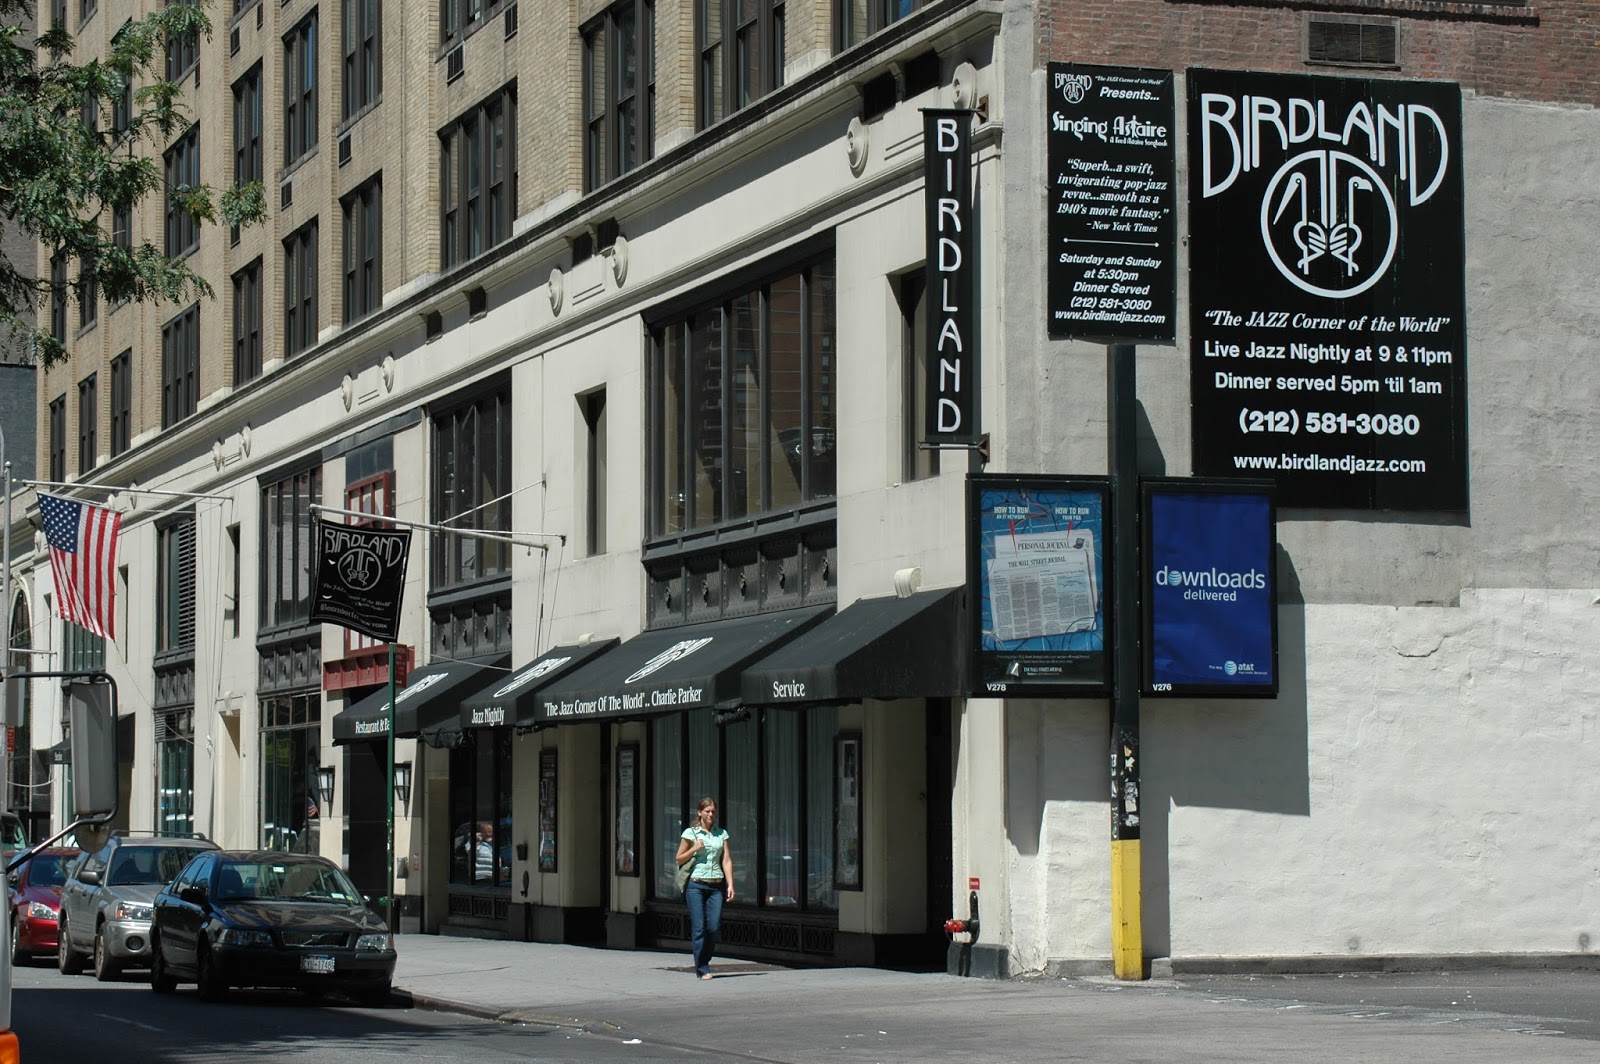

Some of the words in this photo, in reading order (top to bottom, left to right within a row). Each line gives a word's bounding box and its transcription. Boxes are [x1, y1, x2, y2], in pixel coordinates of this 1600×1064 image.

[1054, 72, 1092, 91] BIRDLAND
[1100, 86, 1160, 101] Presents...
[1052, 111, 1108, 143] Singing
[1113, 115, 1167, 138] Astaire
[1127, 138, 1144, 146] Astaire
[1145, 139, 1168, 148] Songbook
[1201, 93, 1449, 207] BIRDLAND
[1125, 163, 1154, 176] swift,
[1057, 173, 1122, 190] invigorating
[1123, 178, 1167, 191] pop-jazz
[1062, 189, 1137, 204] revue...smooth
[1139, 195, 1151, 204] as
[1152, 196, 1160, 204] a
[1056, 202, 1087, 215] 1940's
[1089, 204, 1118, 217] movie
[1120, 206, 1169, 220] fantasy."
[1112, 221, 1132, 232] York
[1133, 221, 1158, 233] Times
[1059, 253, 1103, 266] Saturday
[1105, 256, 1124, 265] and
[1126, 256, 1161, 268] Sunday
[937, 118, 962, 433] BIRDLAND
[1084, 270, 1095, 279] at
[1097, 270, 1139, 281] 5:30pm
[1073, 282, 1109, 293] Dinner
[1110, 283, 1150, 295] Served
[1070, 296, 1097, 309] (212)
[1098, 298, 1152, 310] 581-3080
[1055, 309, 1166, 324] www.birdlandjazz.com
[1204, 310, 1242, 327] "The
[1245, 311, 1290, 328] JAZZ
[1292, 313, 1346, 330] Corner
[1348, 315, 1366, 332] of
[1370, 316, 1395, 332] the
[1399, 317, 1450, 333] World"
[1204, 340, 1240, 357] Live
[1245, 342, 1285, 359] Jazz
[1290, 343, 1350, 364] Nightly
[1354, 346, 1372, 362] at
[1378, 345, 1391, 362] 9
[1395, 346, 1408, 363] &
[1411, 347, 1452, 366] 11pm
[1215, 372, 1271, 390] Dinner
[1276, 374, 1336, 392] served
[1340, 375, 1379, 394] 5pm
[1384, 377, 1404, 393] 'til
[1408, 377, 1442, 394] 1am
[1239, 407, 1300, 435] (212)
[1305, 412, 1420, 436] 581-3080
[1233, 453, 1426, 474] www.birdlandjazz.com
[994, 506, 1008, 514] HOW
[1008, 506, 1015, 514] TO
[1055, 507, 1069, 515] HOW
[1069, 507, 1077, 515] TO
[1078, 507, 1090, 515] RUN
[325, 528, 403, 567] BIRDLAND
[1017, 542, 1045, 551] PERSONAL
[1156, 565, 1266, 589] downloads
[1183, 589, 1237, 602] delivered
[1238, 663, 1254, 671] at&t
[773, 679, 806, 698] Service
[986, 683, 1007, 692] V278
[1152, 683, 1172, 691] V276
[558, 701, 573, 715] Jazz
[574, 698, 597, 714] Corner
[598, 696, 607, 712] Of
[608, 695, 621, 711] The
[651, 689, 676, 707] Charlie
[677, 686, 702, 703] Parker
[471, 709, 484, 724] Jazz
[484, 707, 505, 726] Nightly
[355, 720, 379, 734] Restaurant
[379, 720, 384, 733] &
